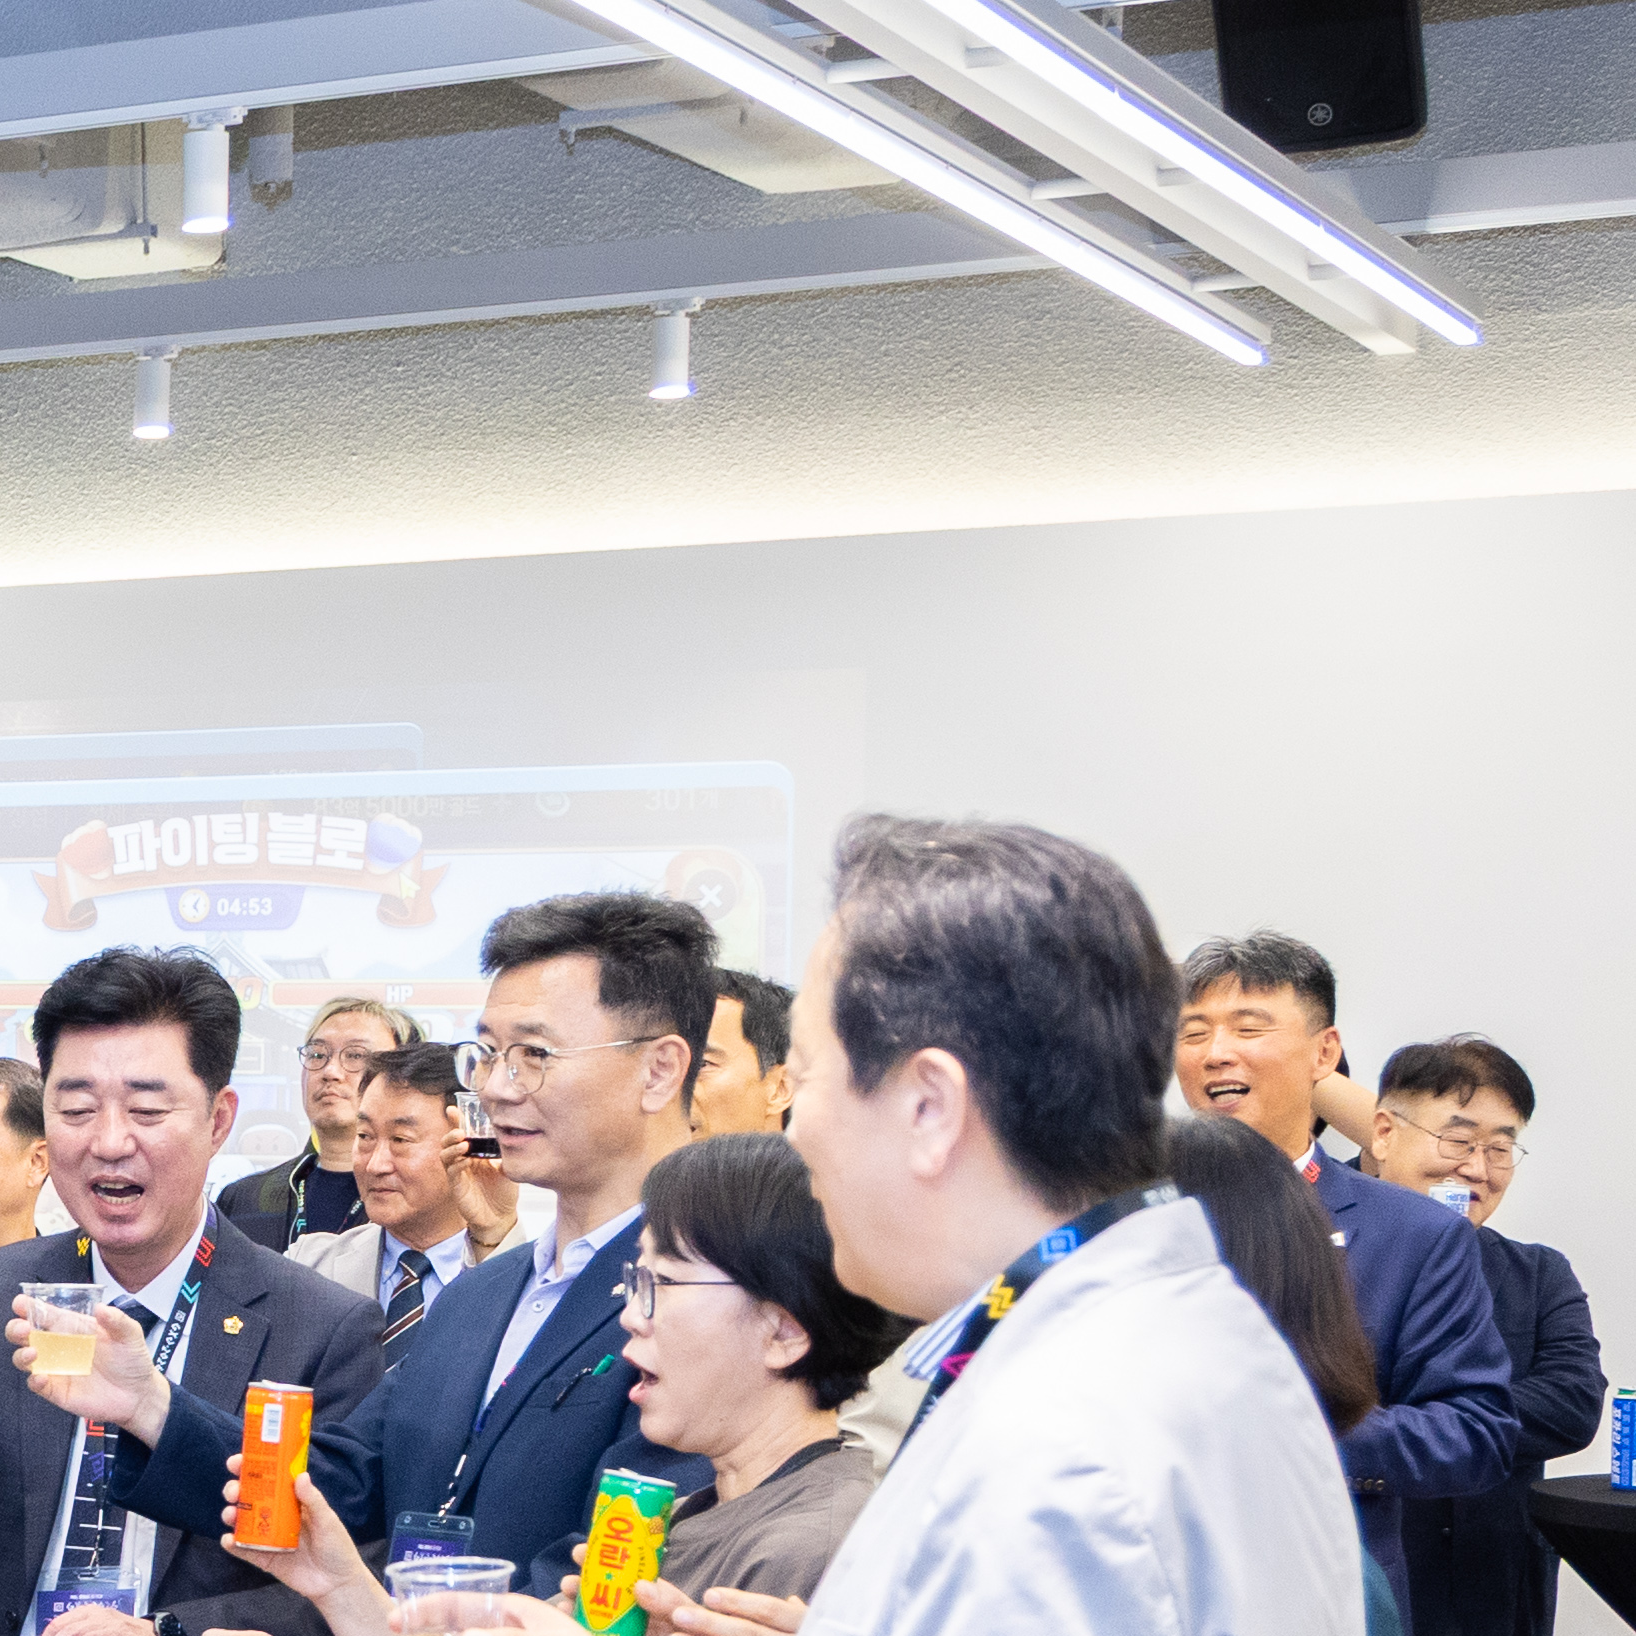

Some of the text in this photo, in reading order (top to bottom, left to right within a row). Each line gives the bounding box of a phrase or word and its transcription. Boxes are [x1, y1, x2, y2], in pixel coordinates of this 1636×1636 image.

[106, 811, 369, 876] 파이팅 블로
[216, 897, 273, 916] 04:53
[385, 984, 414, 1004] HP
